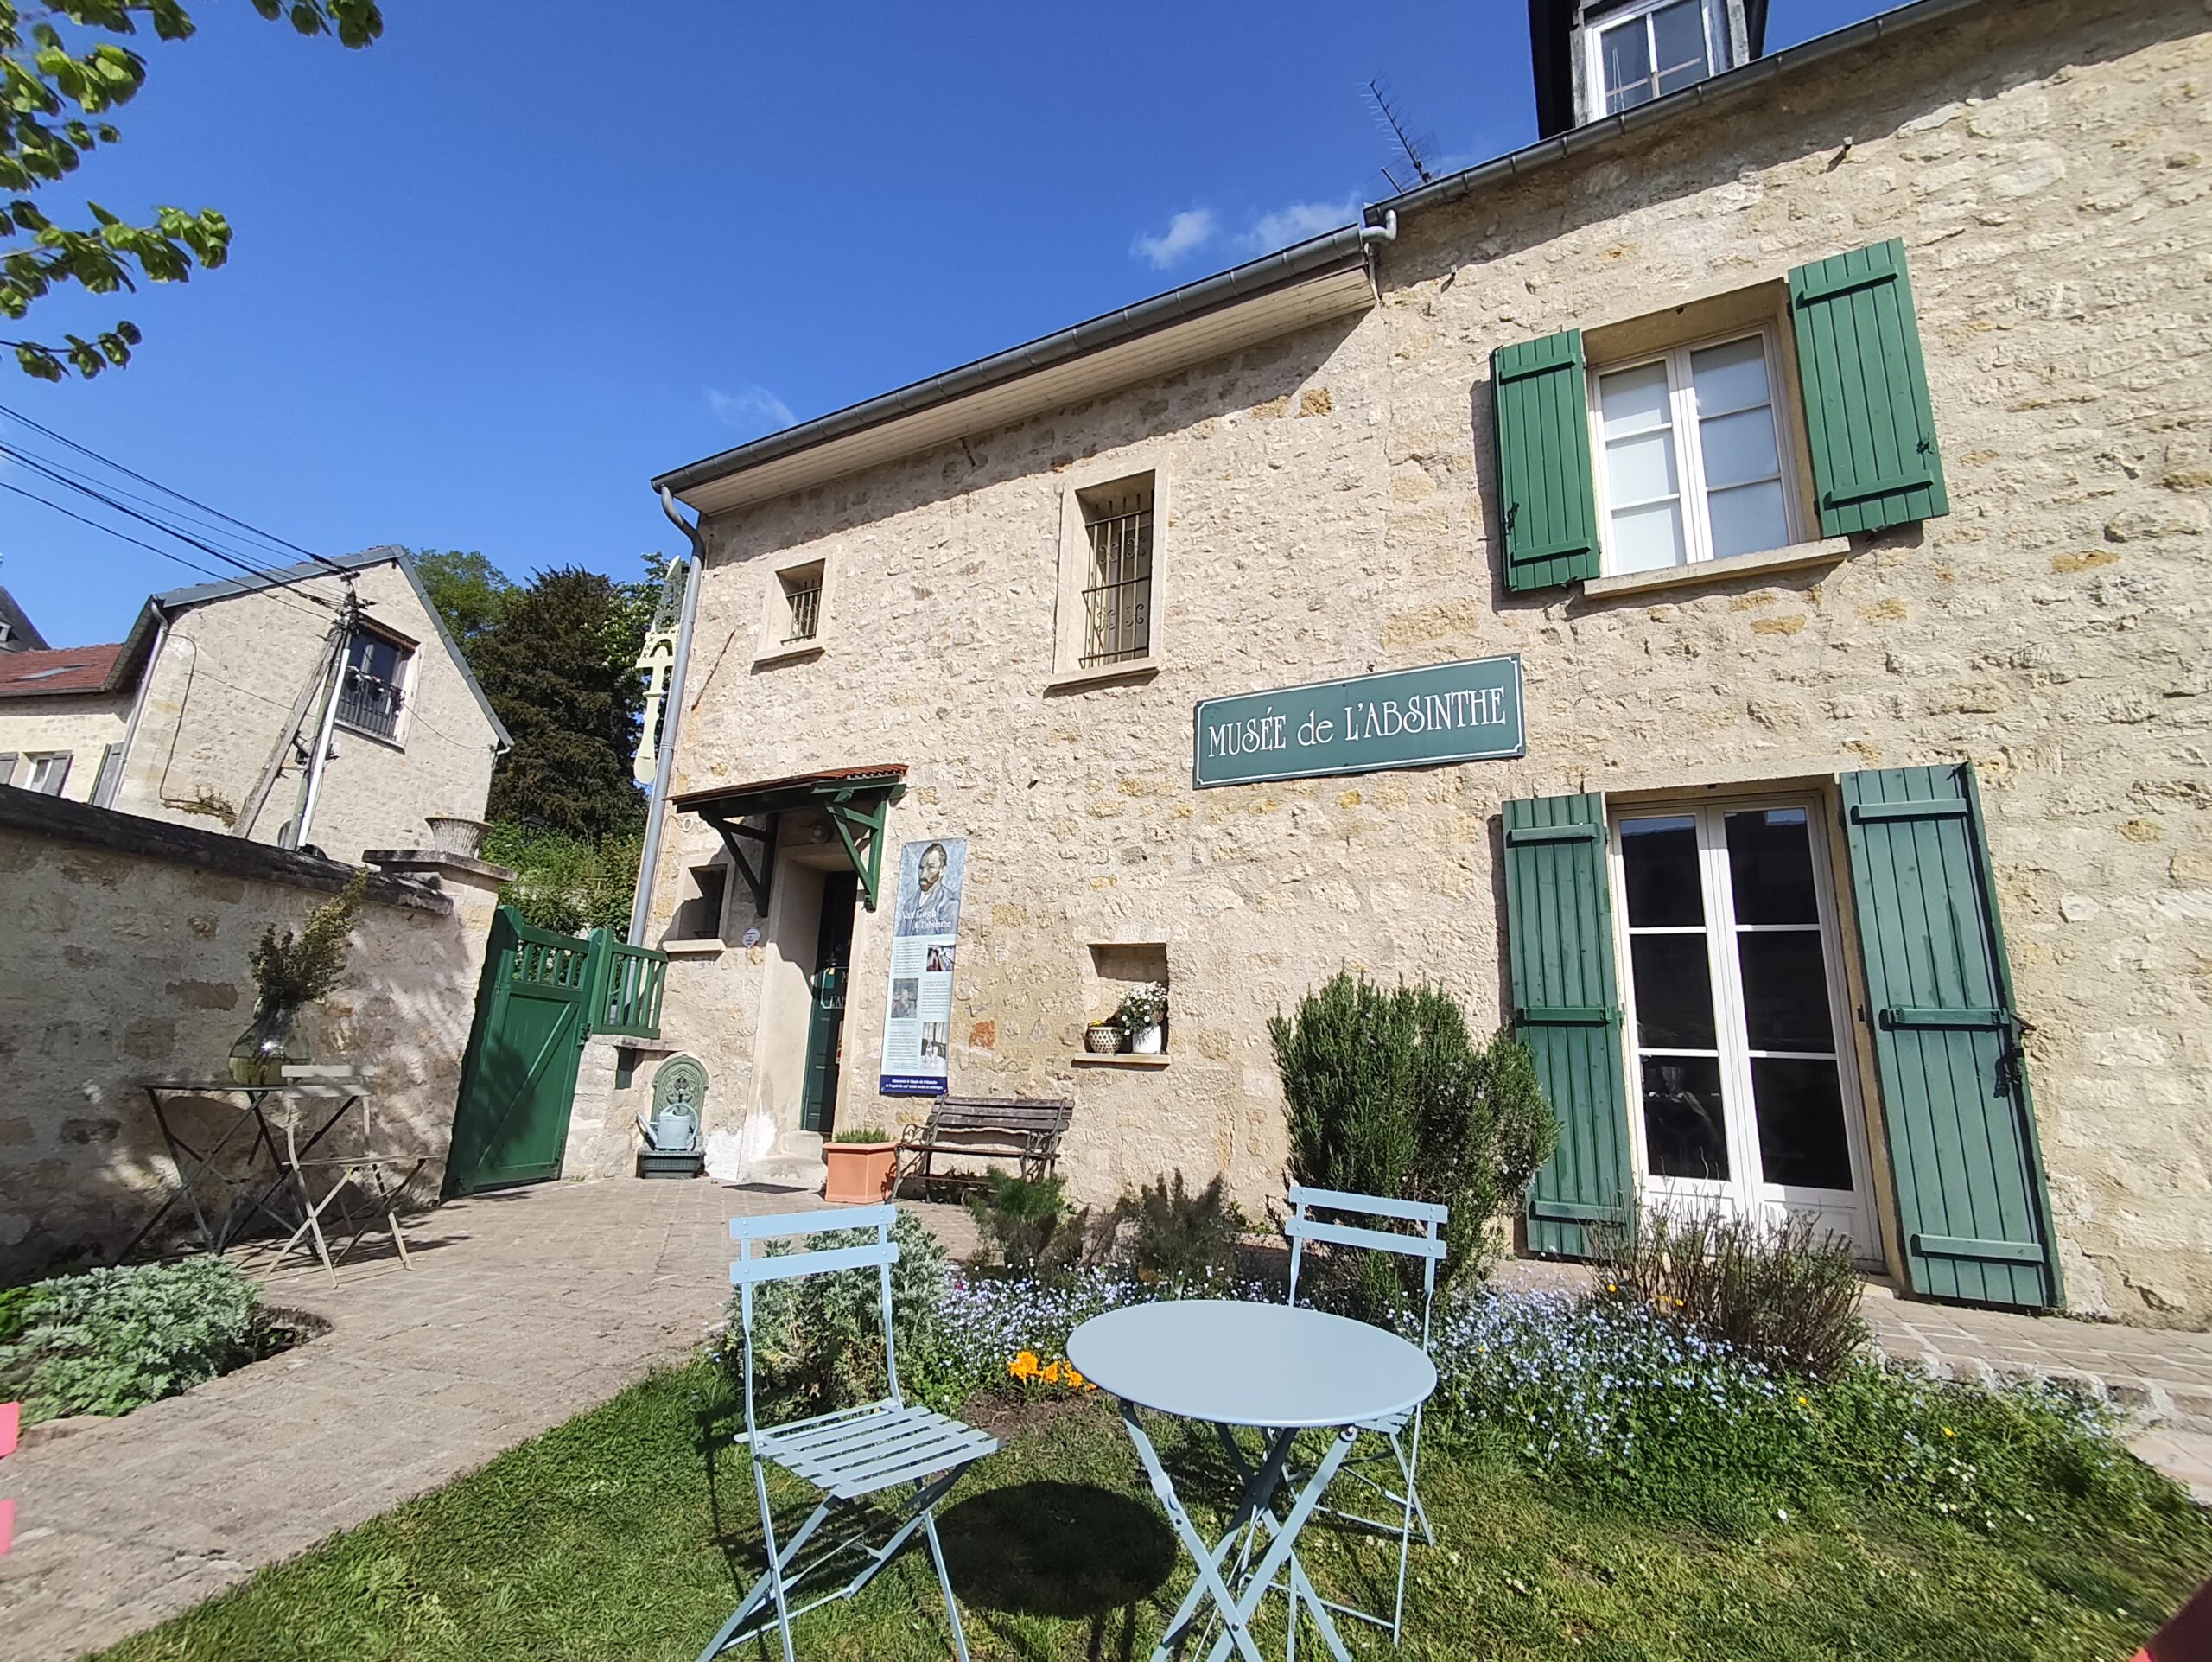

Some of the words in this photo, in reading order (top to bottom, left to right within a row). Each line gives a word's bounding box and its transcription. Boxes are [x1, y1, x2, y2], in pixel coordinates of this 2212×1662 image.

[1208, 706, 1287, 758] MUSÉE
[1297, 708, 1334, 747] de
[1344, 685, 1506, 742] L'ABSINTHE
[902, 910, 914, 920] Van
[916, 907, 937, 920] Gogh
